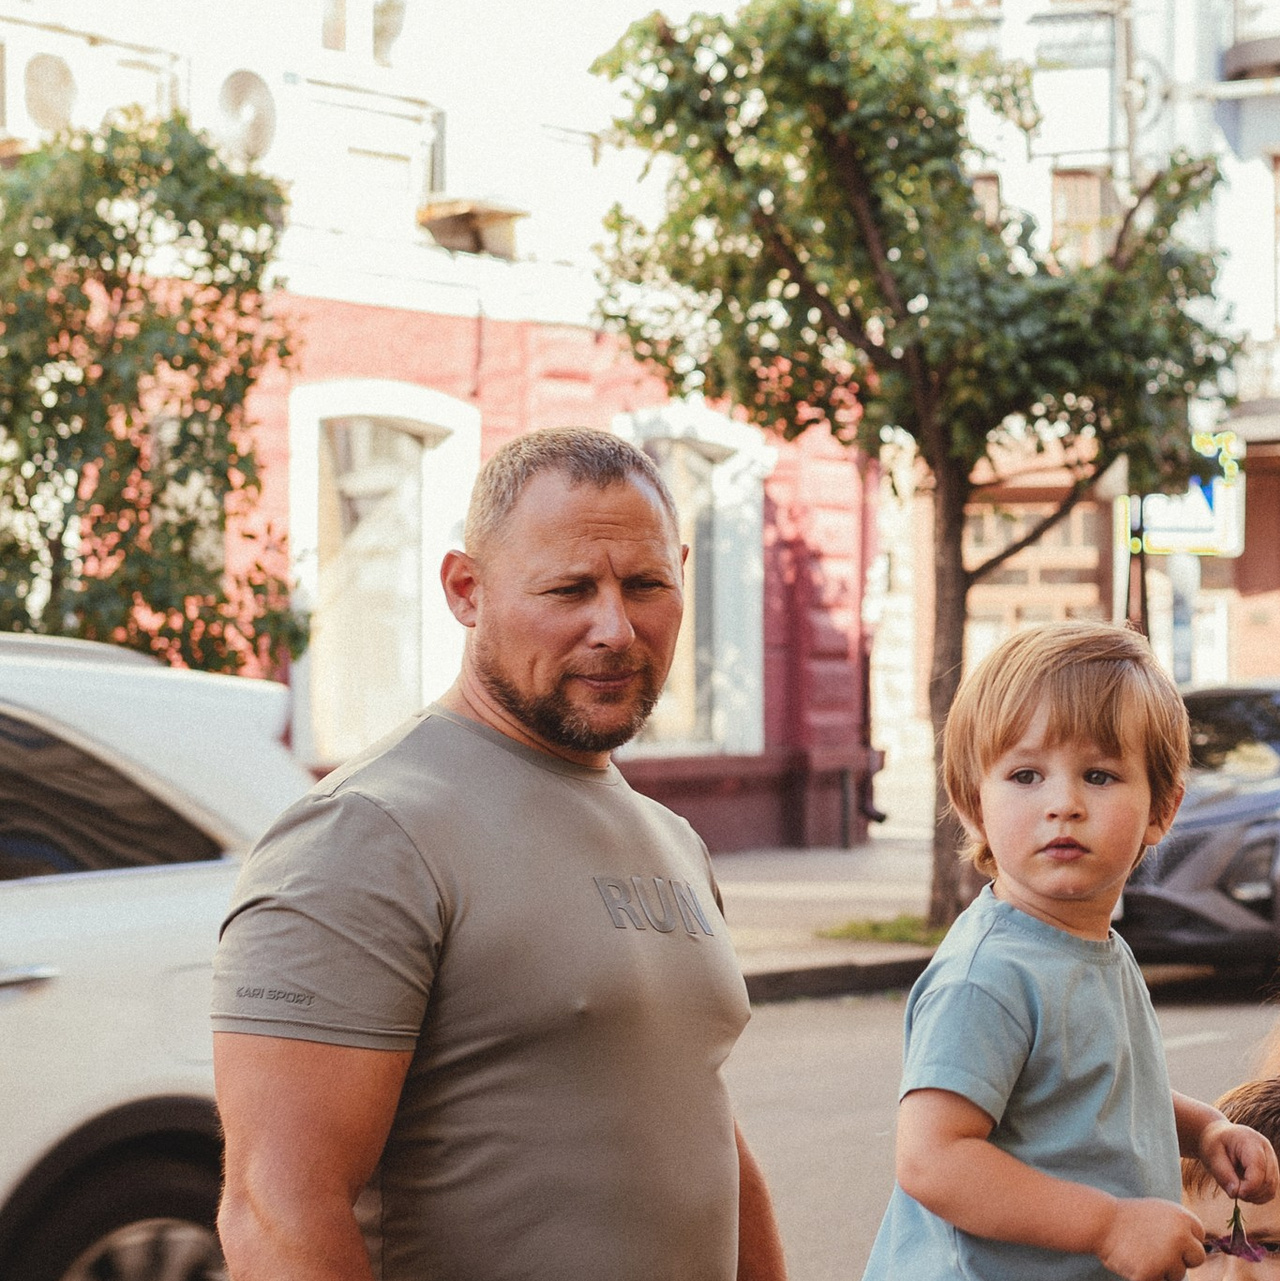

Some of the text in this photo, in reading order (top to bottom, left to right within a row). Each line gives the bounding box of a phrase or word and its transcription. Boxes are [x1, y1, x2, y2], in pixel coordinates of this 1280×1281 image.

[592, 876, 715, 936] RUN
[235, 986, 316, 1006] KARI SPORT
